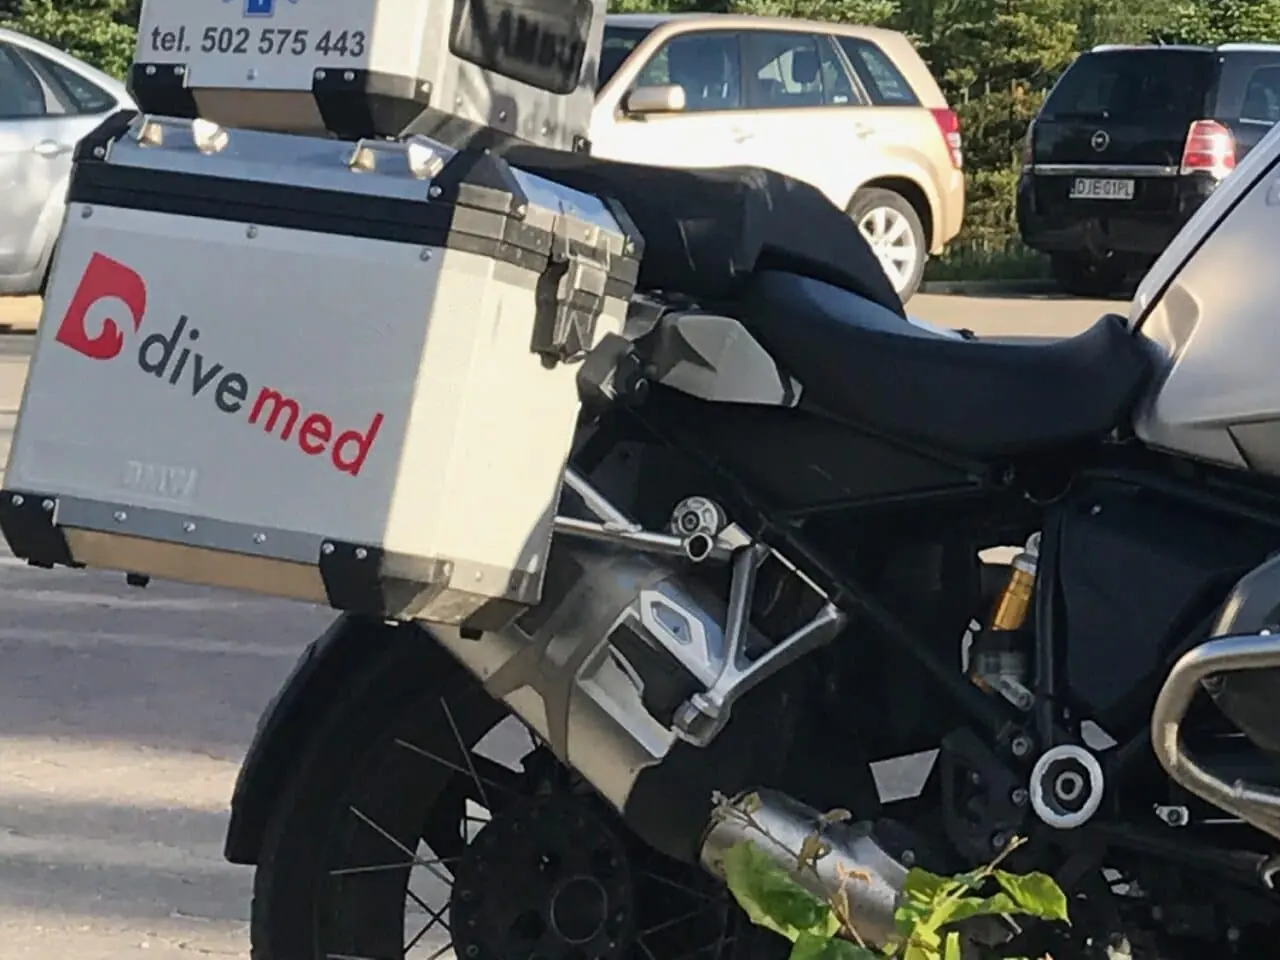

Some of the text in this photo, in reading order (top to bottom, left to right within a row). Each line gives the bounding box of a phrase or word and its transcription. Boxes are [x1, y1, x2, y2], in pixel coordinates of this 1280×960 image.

[151, 25, 365, 58] tel. 502 575 443
[137, 314, 385, 478] divemed
